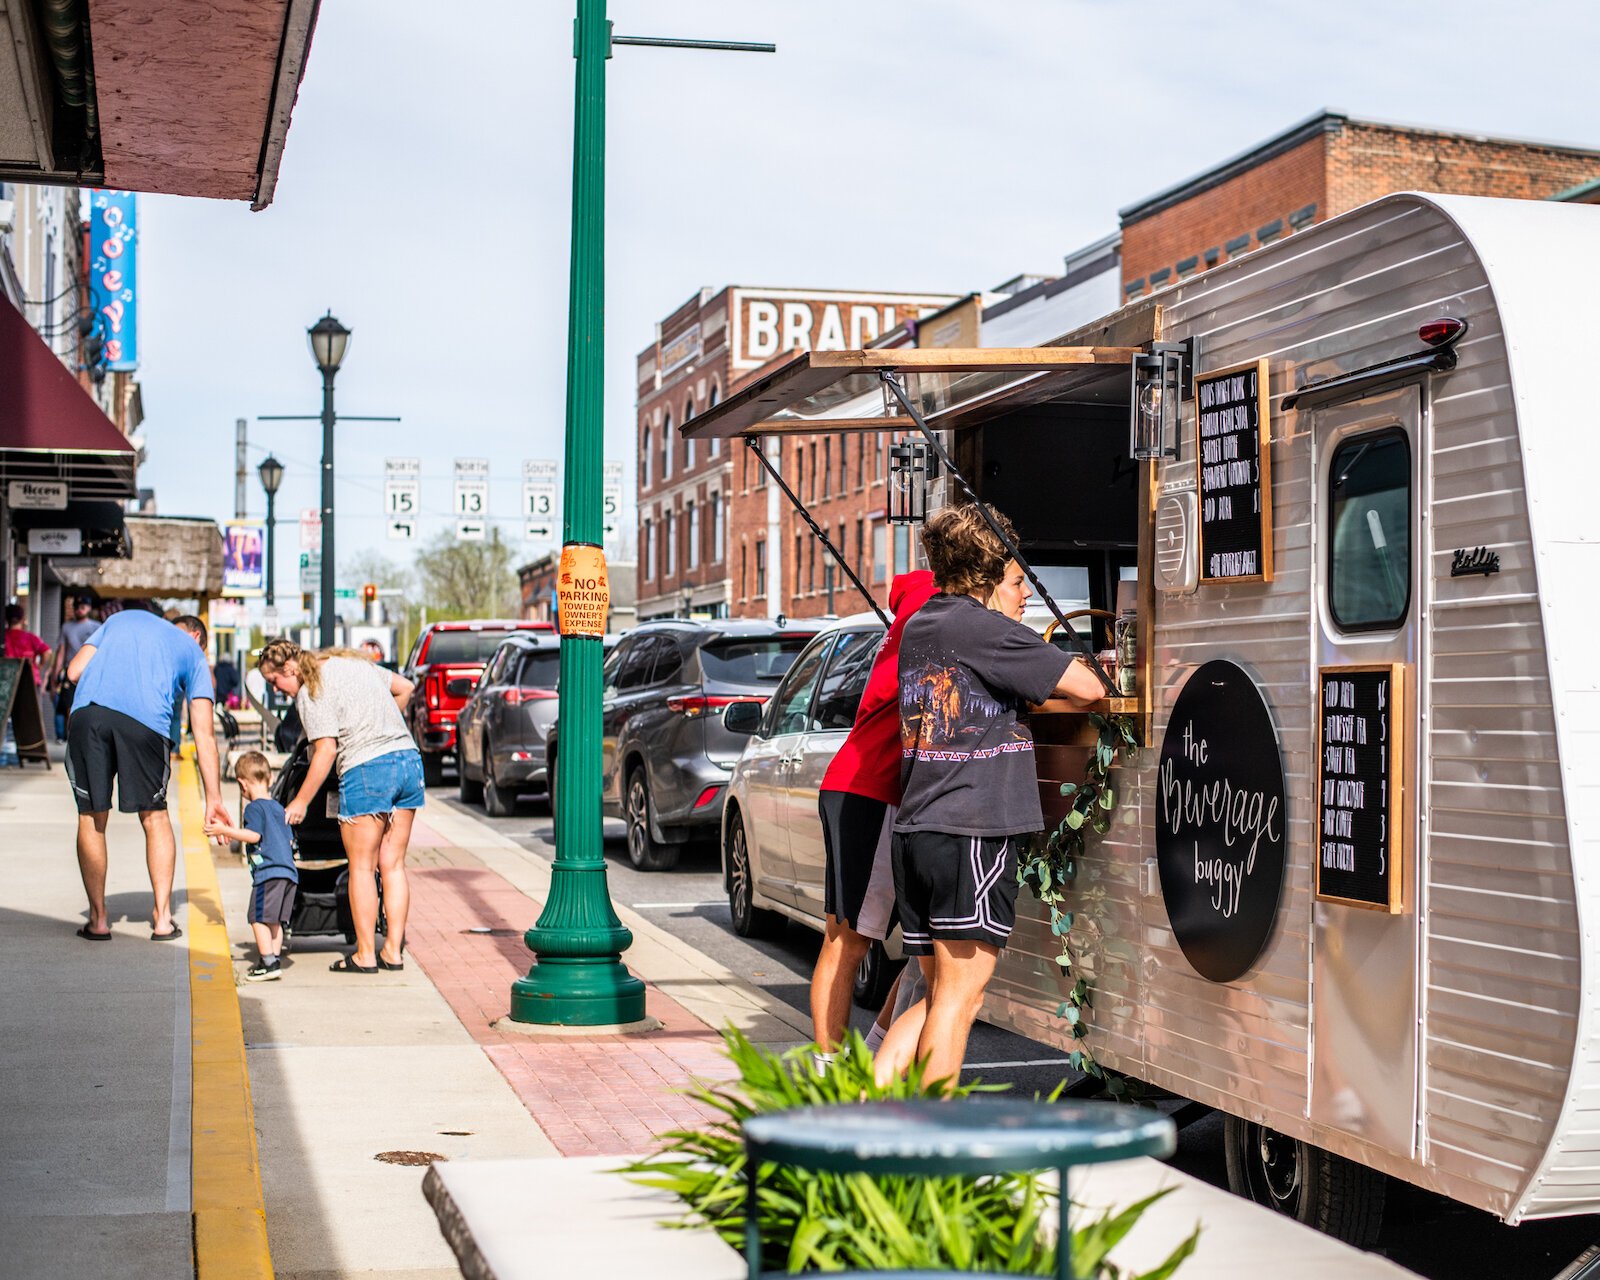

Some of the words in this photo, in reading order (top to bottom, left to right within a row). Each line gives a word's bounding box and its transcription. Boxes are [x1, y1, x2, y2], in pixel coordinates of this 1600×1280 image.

[748, 300, 940, 357] BRAD
[385, 461, 420, 472] NORTH
[455, 461, 488, 472] NORTH
[525, 464, 557, 474] SOUTH
[603, 465, 622, 474] UTH
[391, 493, 413, 512] 15
[460, 493, 482, 512] 13
[529, 495, 550, 514] 13
[604, 496, 616, 514] 5
[574, 578, 596, 590] NO
[560, 591, 608, 602] PARKING
[564, 611, 603, 619] OWNER'S
[565, 620, 602, 628] EXPENSE
[1356, 716, 1367, 744] TEA
[1379, 713, 1386, 741] 5
[1183, 720, 1208, 767] the
[1345, 747, 1355, 774] TEA
[1161, 757, 1280, 875] Beverage
[1379, 814, 1386, 842] 3
[1379, 848, 1386, 876] 5
[1194, 840, 1243, 918] buggy
